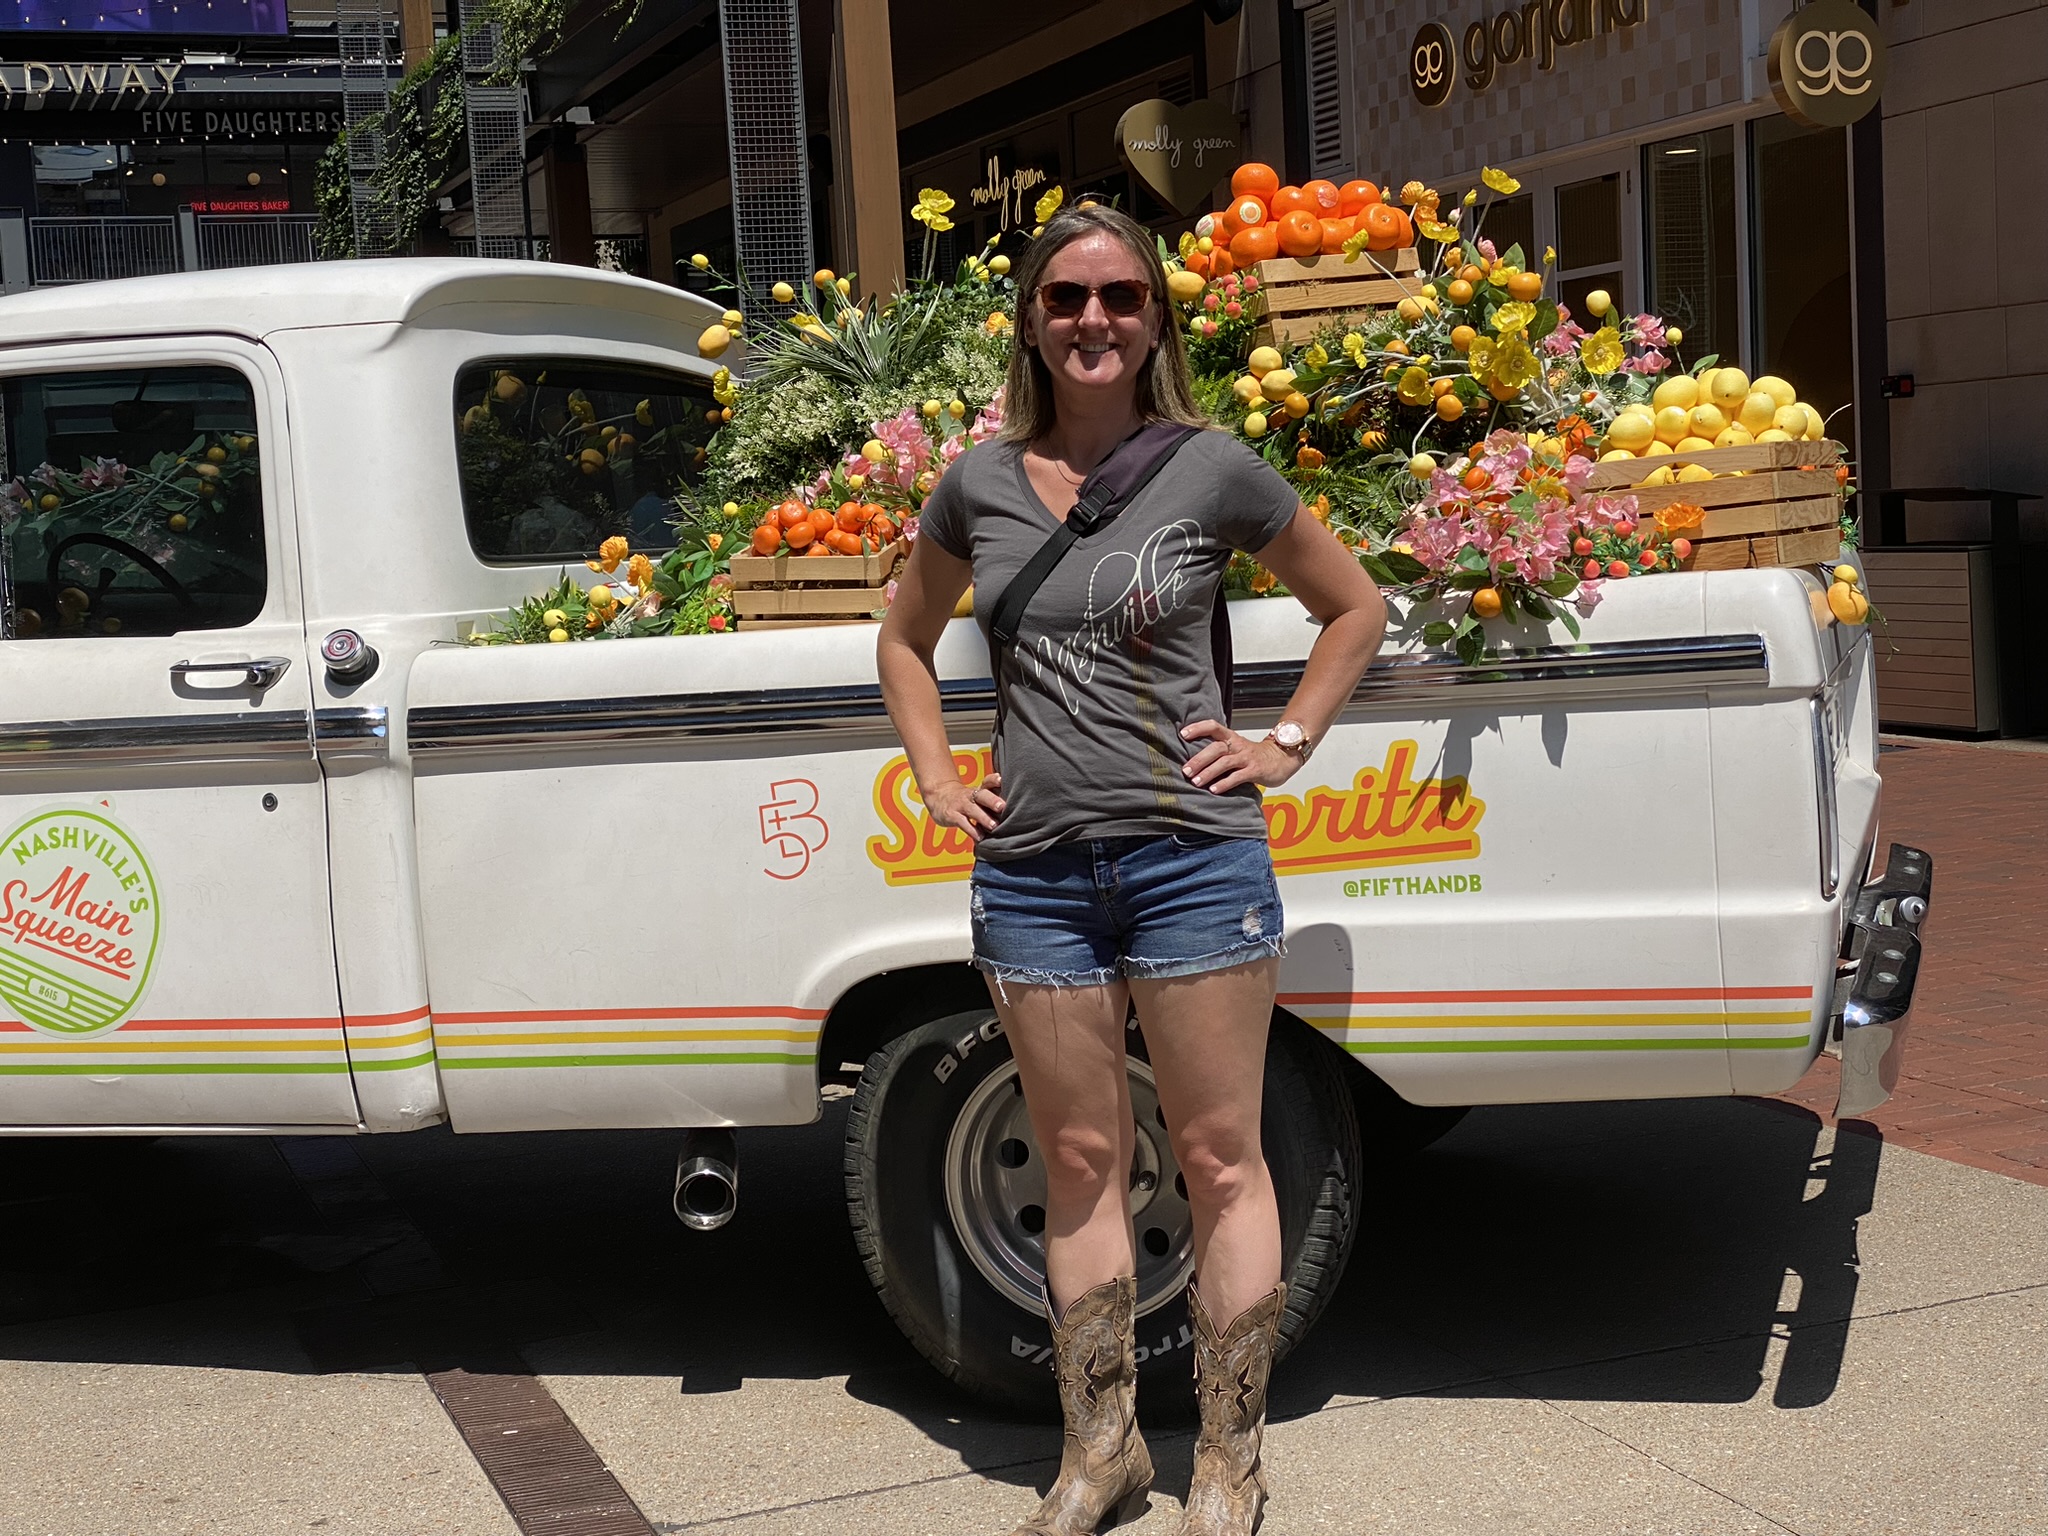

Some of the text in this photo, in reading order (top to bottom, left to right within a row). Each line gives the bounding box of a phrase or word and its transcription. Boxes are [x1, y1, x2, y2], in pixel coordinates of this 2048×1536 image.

[142, 111, 342, 133] FIVE DAUGHTERS
[1129, 124, 1237, 168] molly green
[191, 201, 290, 211] FIVE DAUGHTERS BAKER
[970, 155, 1047, 232] molly green
[1260, 745, 1479, 850] pritz
[11, 825, 149, 914] NASHVILLE'S
[30, 865, 134, 937] Main
[1343, 873, 1483, 898] @FIFTHANDB
[0, 878, 137, 970] Squeeze
